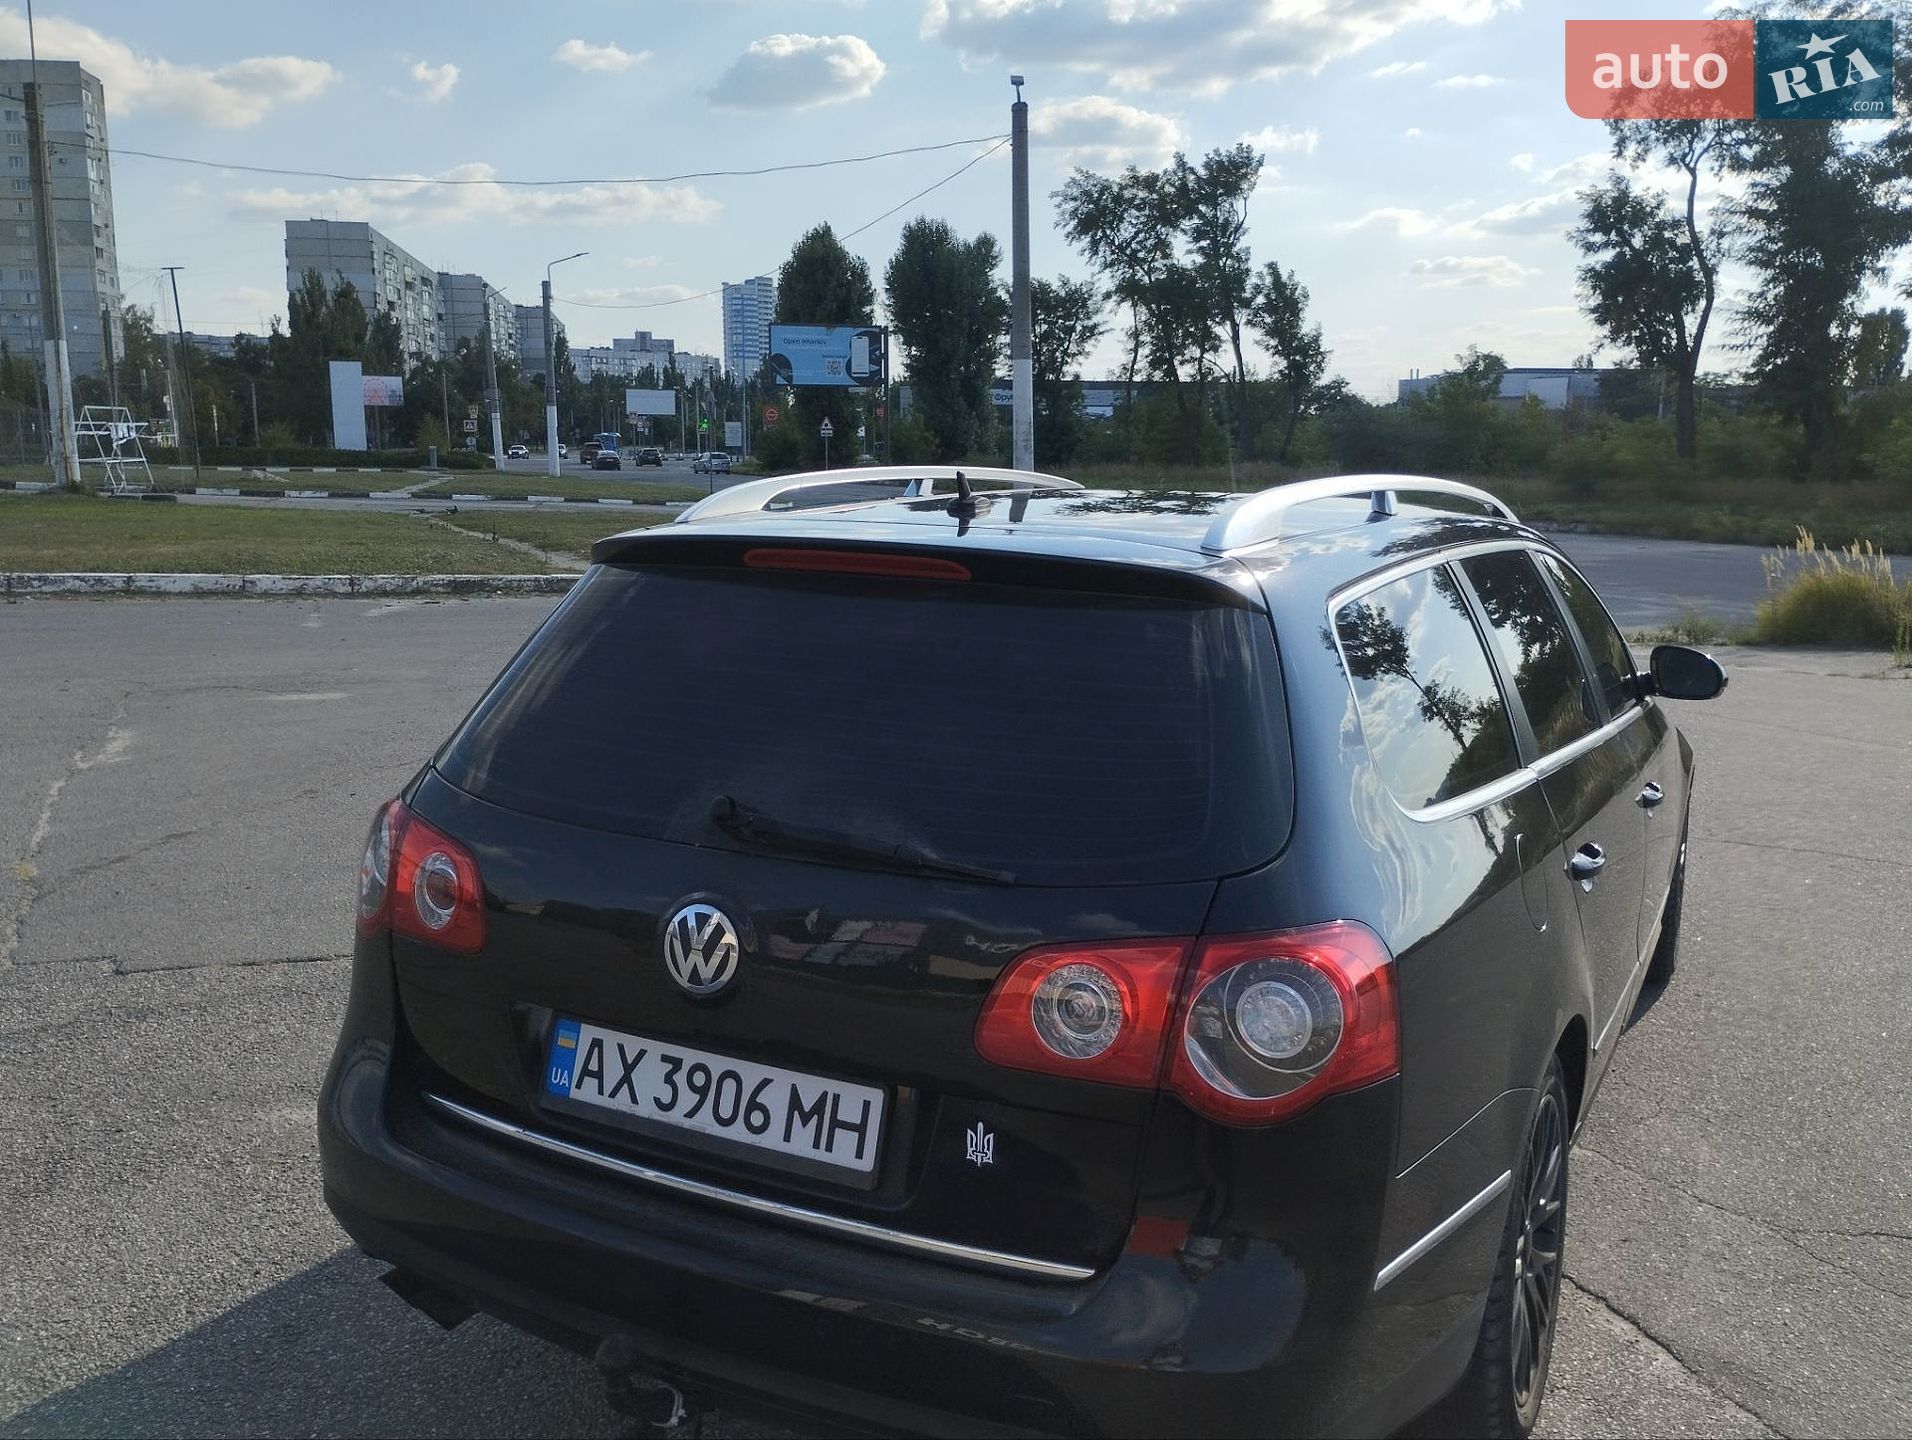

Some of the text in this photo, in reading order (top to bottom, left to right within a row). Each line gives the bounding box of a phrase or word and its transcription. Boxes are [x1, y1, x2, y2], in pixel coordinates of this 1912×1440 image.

[664, 904, 739, 995] VW
[551, 1067, 570, 1088] UA
[575, 1037, 872, 1160] AX 3906 MH
